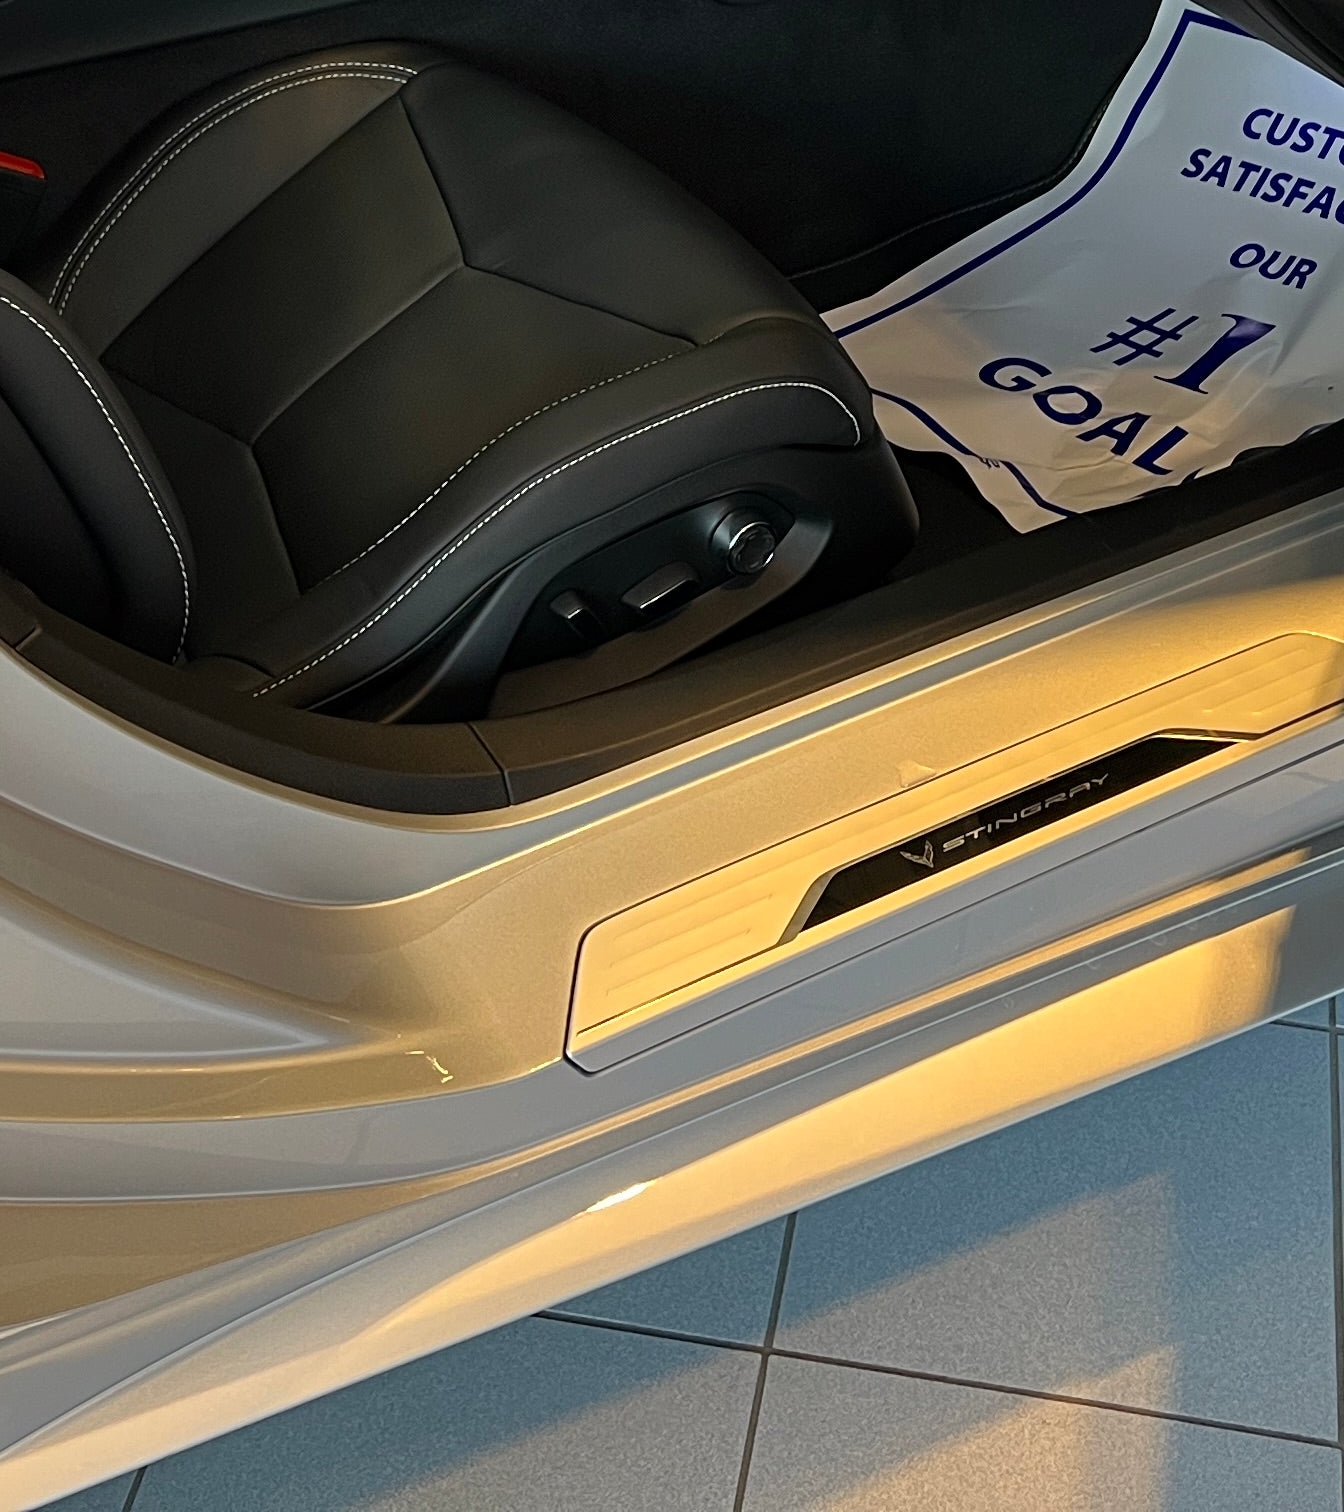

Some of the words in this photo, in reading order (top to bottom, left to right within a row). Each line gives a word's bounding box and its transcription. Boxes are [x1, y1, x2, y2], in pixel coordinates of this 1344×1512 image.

[1229, 243, 1318, 289] OUR
[1089, 307, 1277, 395] #1
[978, 357, 1189, 476] GOAL
[942, 773, 1109, 853] STINGRAY
